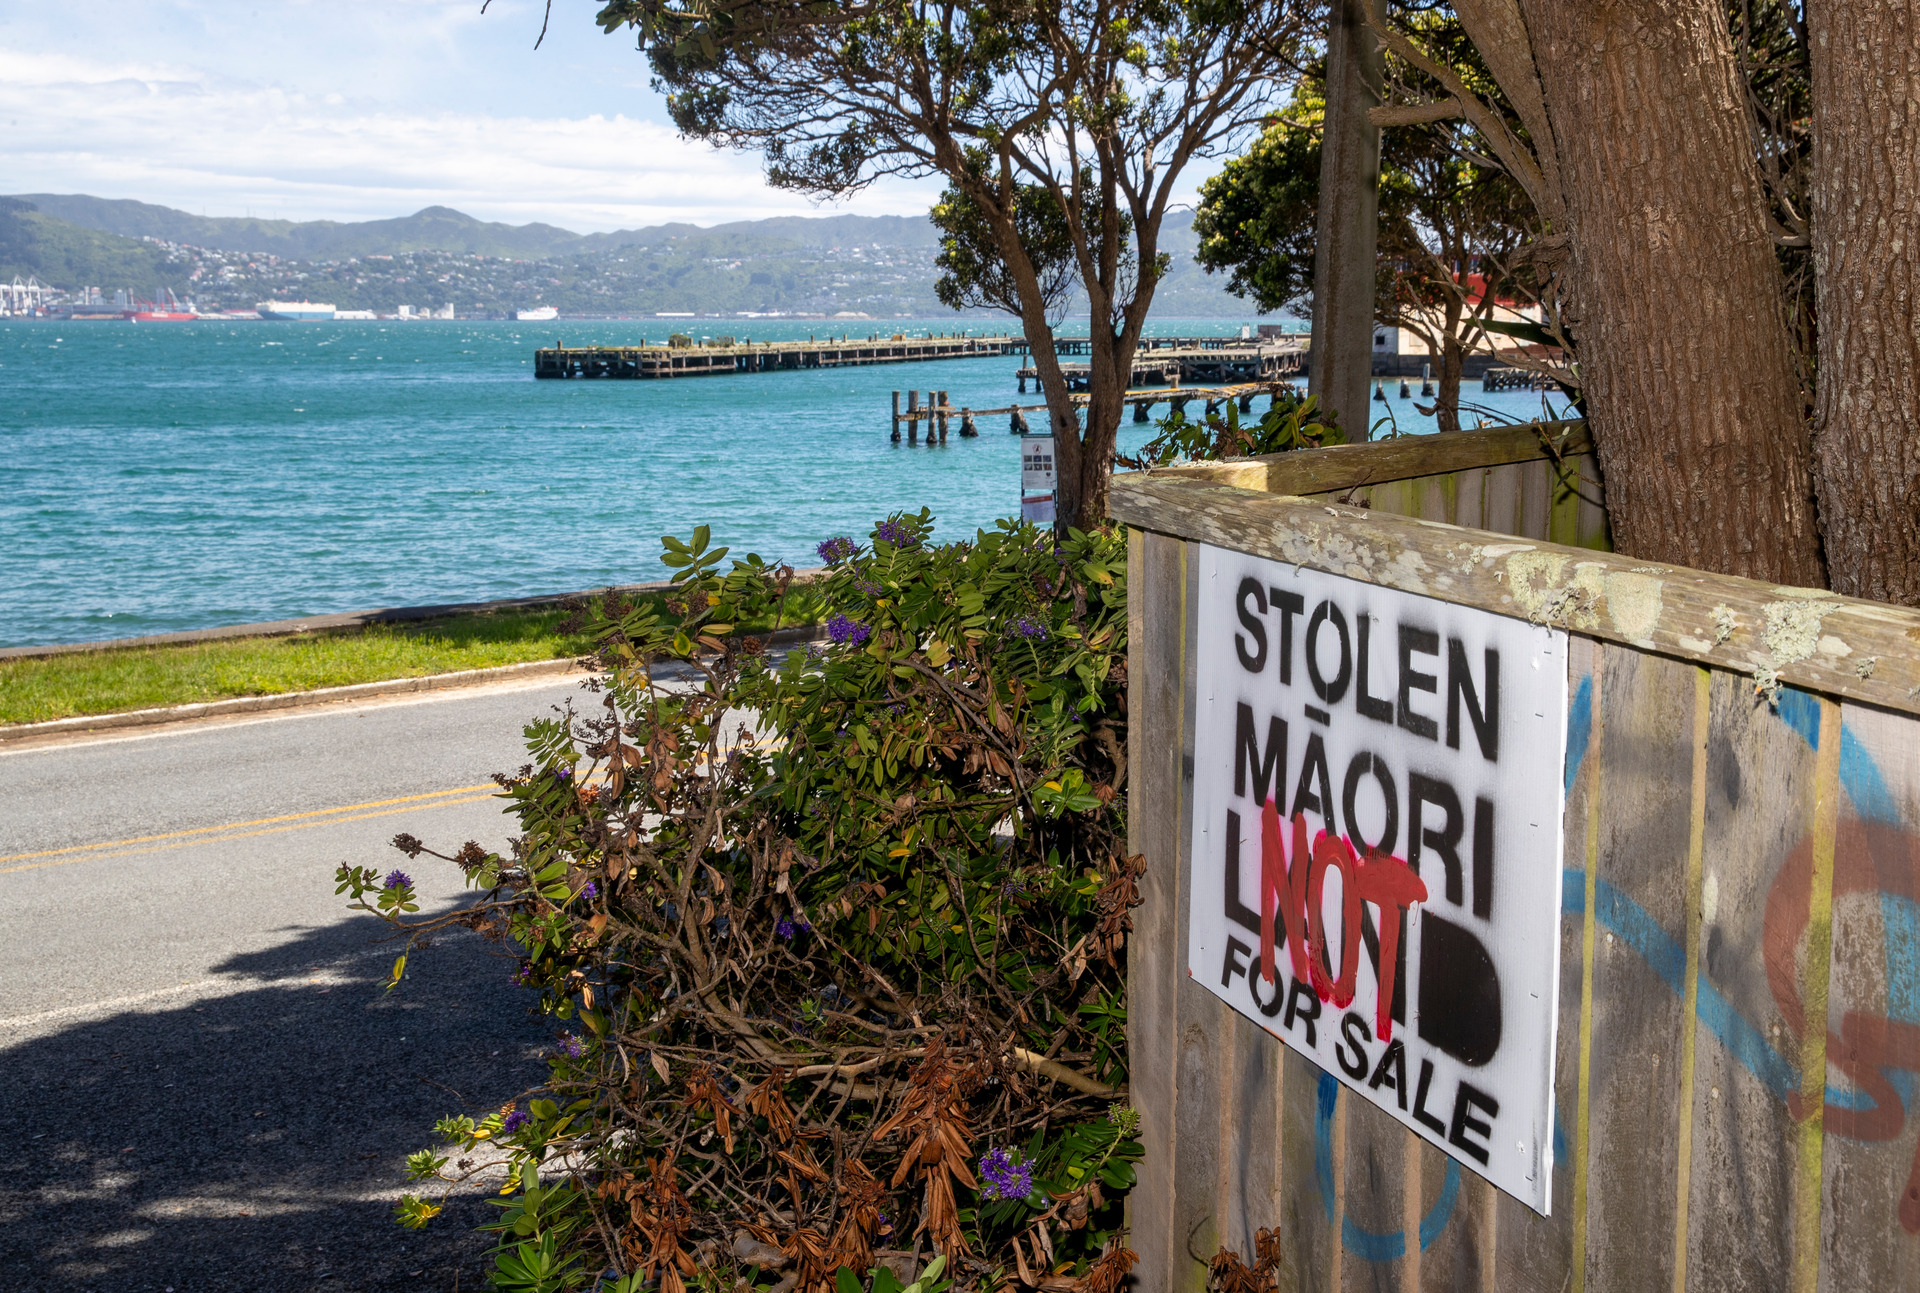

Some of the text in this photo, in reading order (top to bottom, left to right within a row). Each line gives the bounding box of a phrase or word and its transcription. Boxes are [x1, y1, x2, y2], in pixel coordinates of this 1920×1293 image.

[1234, 576, 1500, 764] STOLEN
[1234, 700, 1494, 922] MĀORI
[1260, 799, 1429, 1042] NOT
[1222, 934, 1499, 1166] FOR SALE
